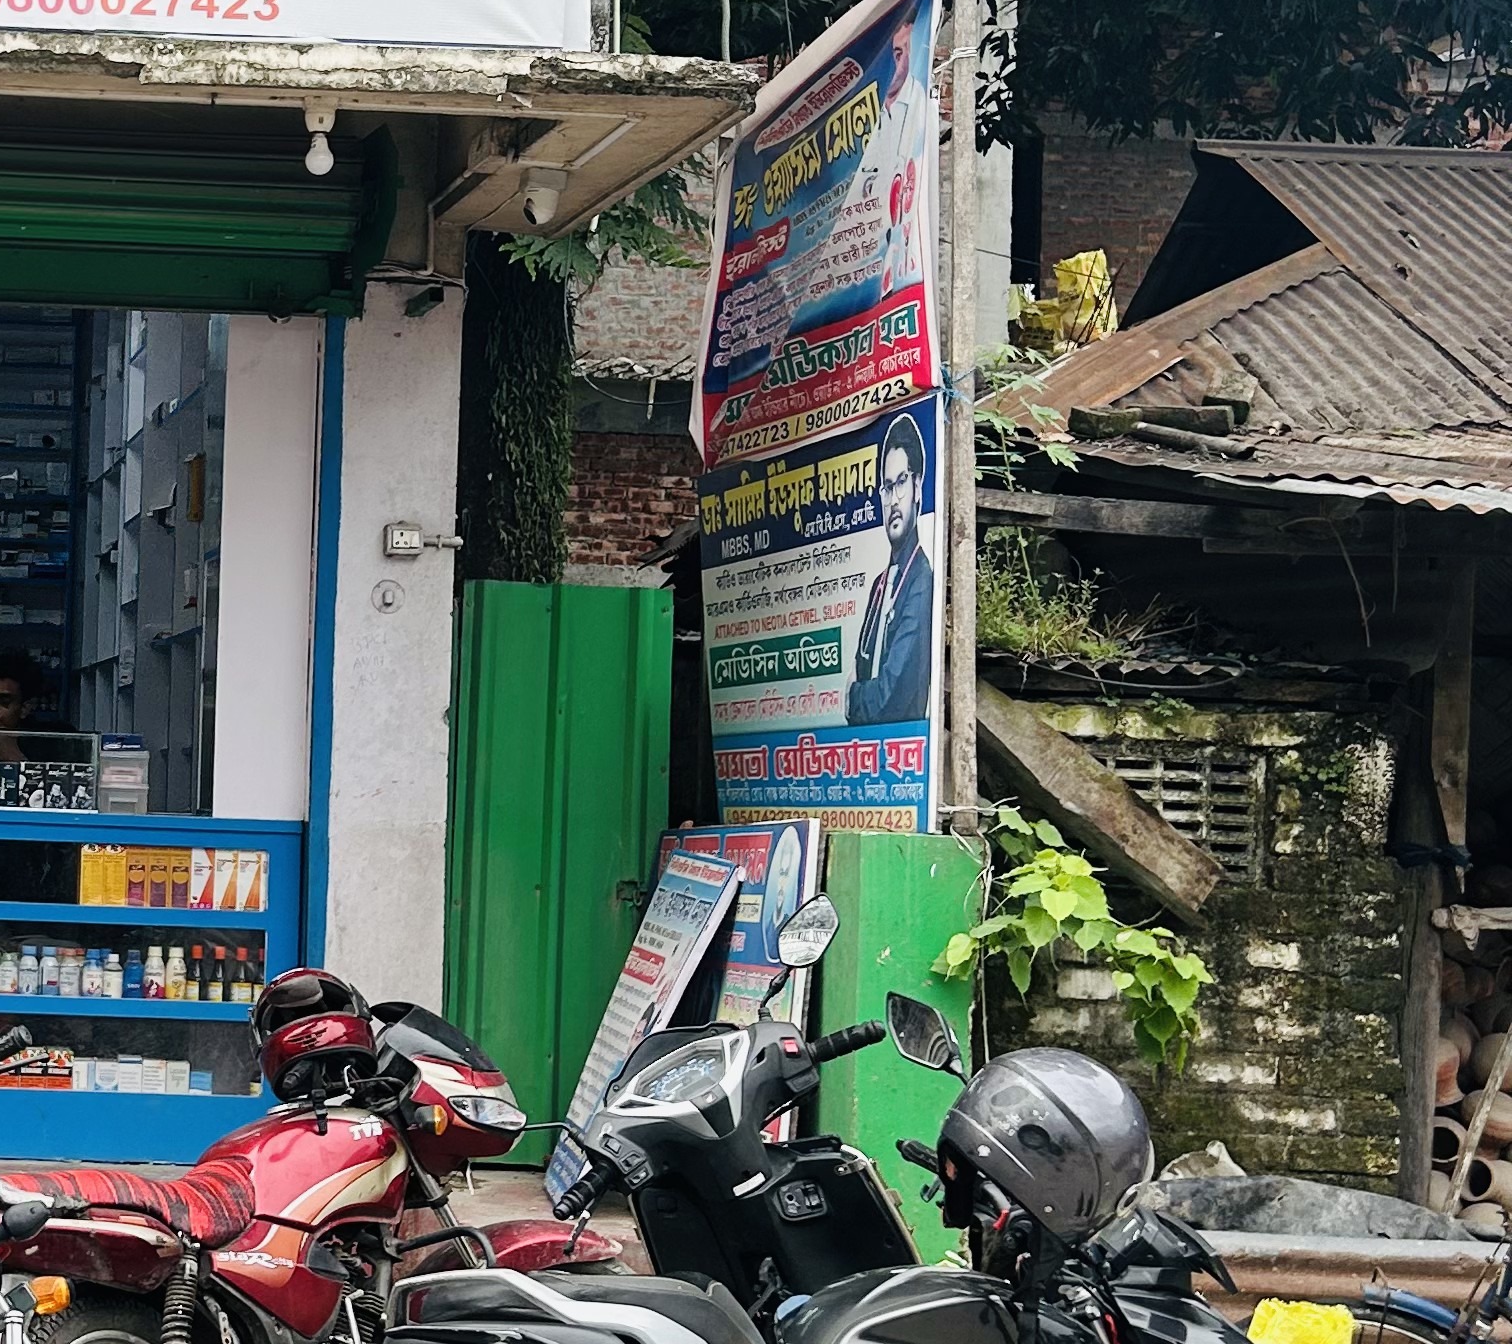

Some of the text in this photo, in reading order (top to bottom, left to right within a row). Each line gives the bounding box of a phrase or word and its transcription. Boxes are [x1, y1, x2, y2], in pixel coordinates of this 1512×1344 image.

[878, 301, 920, 347] হল
[806, 379, 911, 431] 9800027423
[721, 529, 770, 559] MBBS, MD
[715, 620, 749, 640] ATTACHED
[750, 617, 760, 635] TO
[715, 644, 778, 683] মেডিসিন
[715, 733, 926, 780] মমতা মেডিক্যাল হল
[822, 810, 912, 829] 9800027423
[349, 1120, 383, 1141] TVS
